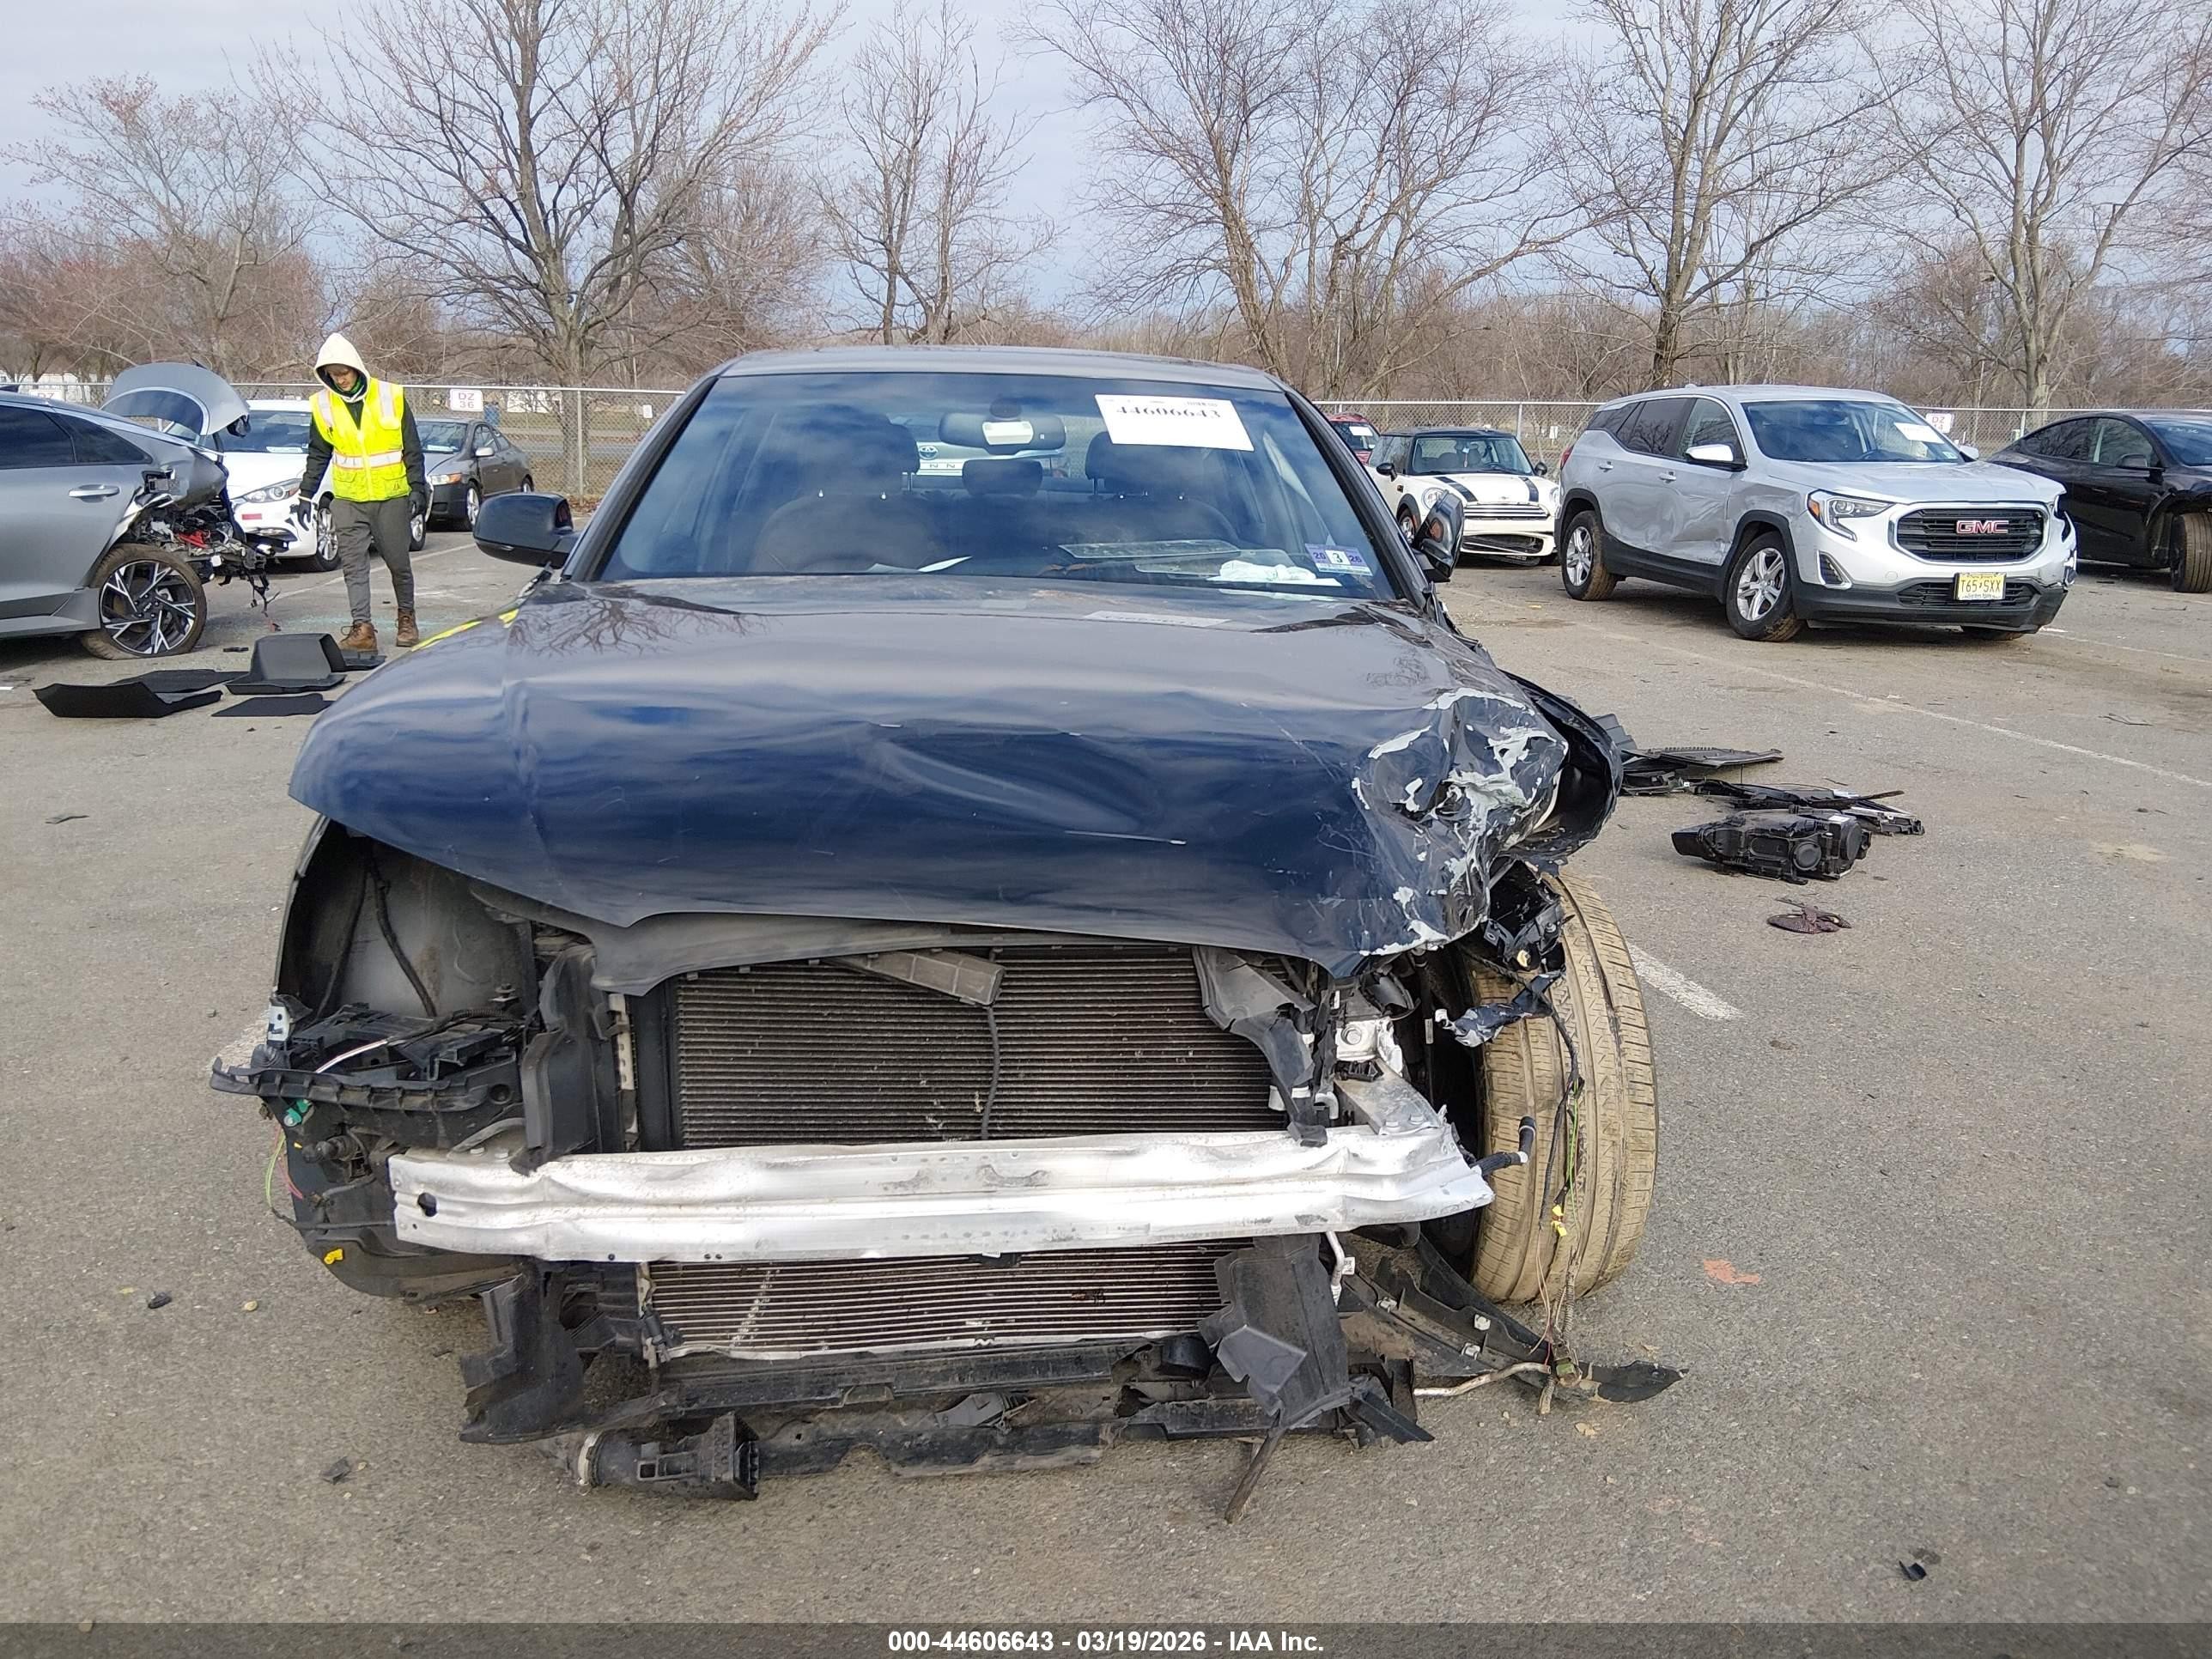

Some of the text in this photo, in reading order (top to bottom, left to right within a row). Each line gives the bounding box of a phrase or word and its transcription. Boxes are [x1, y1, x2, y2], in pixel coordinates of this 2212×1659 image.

[459, 392, 475, 401] DZ
[1956, 520, 2009, 533] GMC
[1332, 552, 1344, 563] 3
